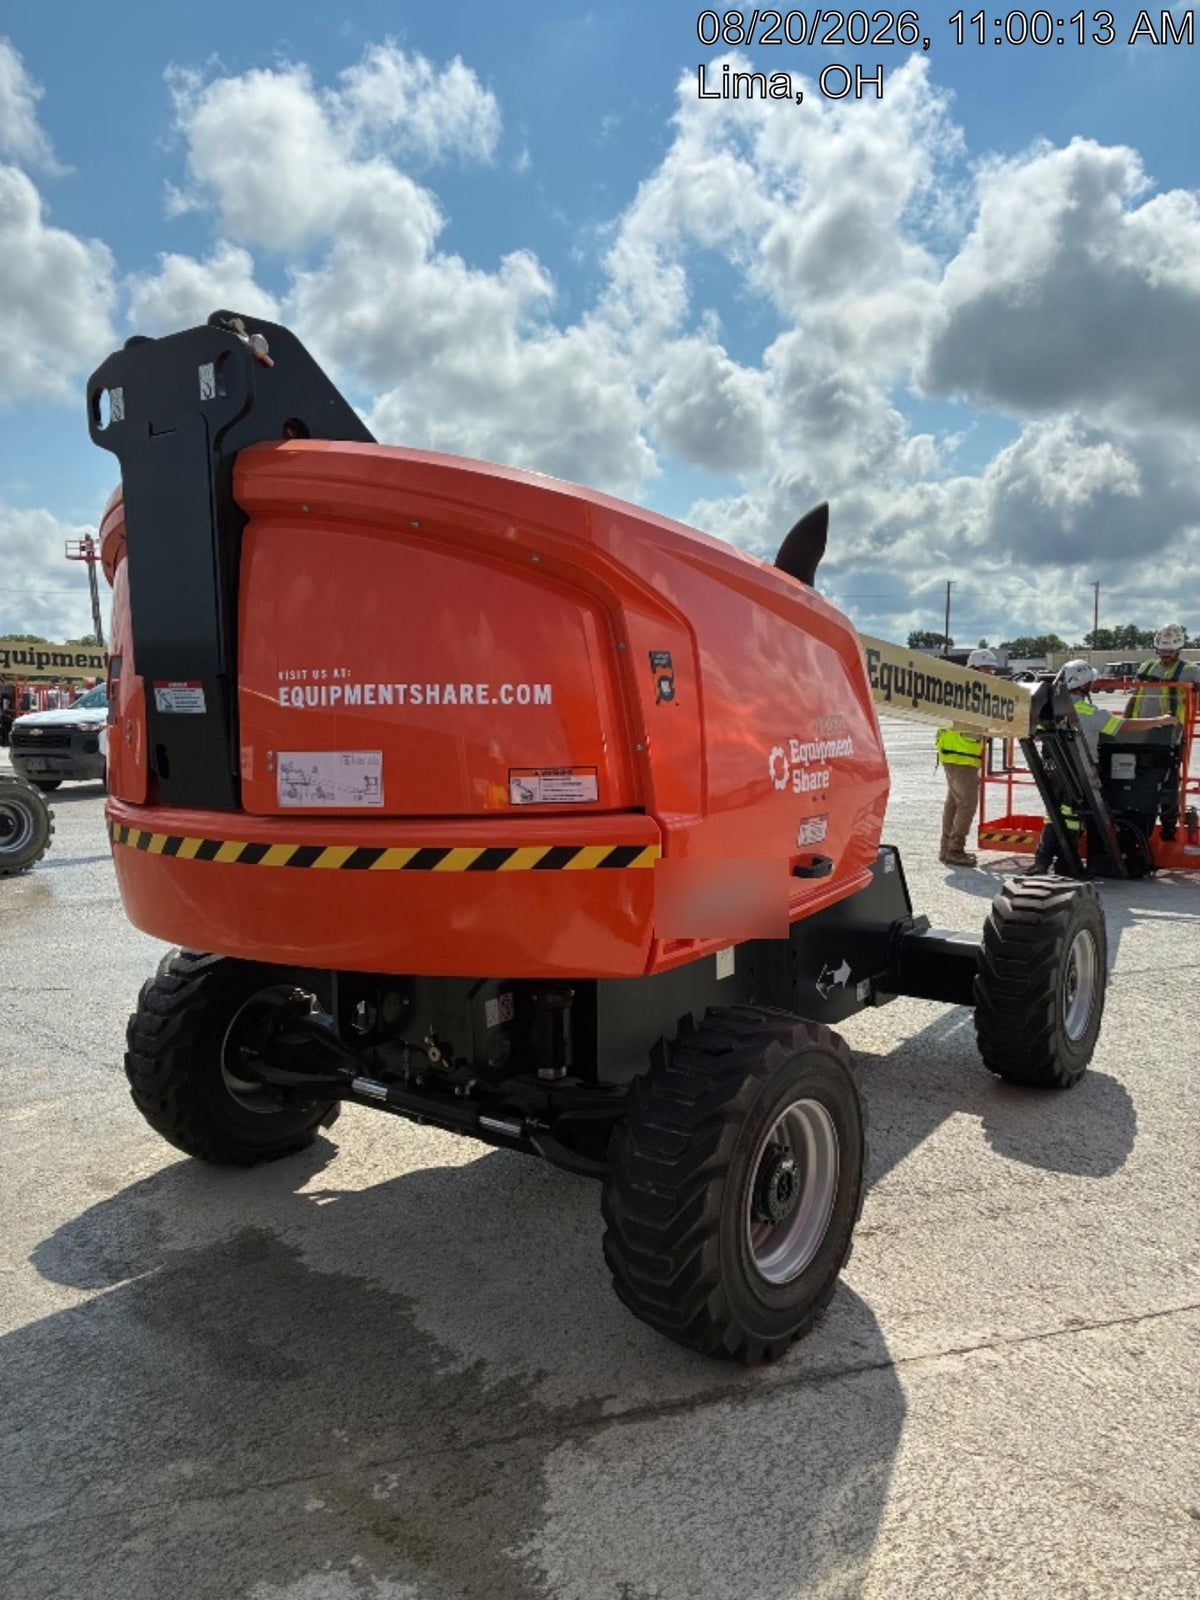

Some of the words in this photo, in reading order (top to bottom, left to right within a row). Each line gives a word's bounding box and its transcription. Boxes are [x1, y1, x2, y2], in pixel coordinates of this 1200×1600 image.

[278, 670, 307, 680] VISIT
[312, 669, 327, 679] US
[333, 668, 352, 678] AT:
[866, 648, 1015, 722] EquipmentShare
[279, 684, 552, 708] EQUIPMENTSHARE.COM
[789, 736, 854, 766] Equipment
[792, 768, 830, 793] Share
